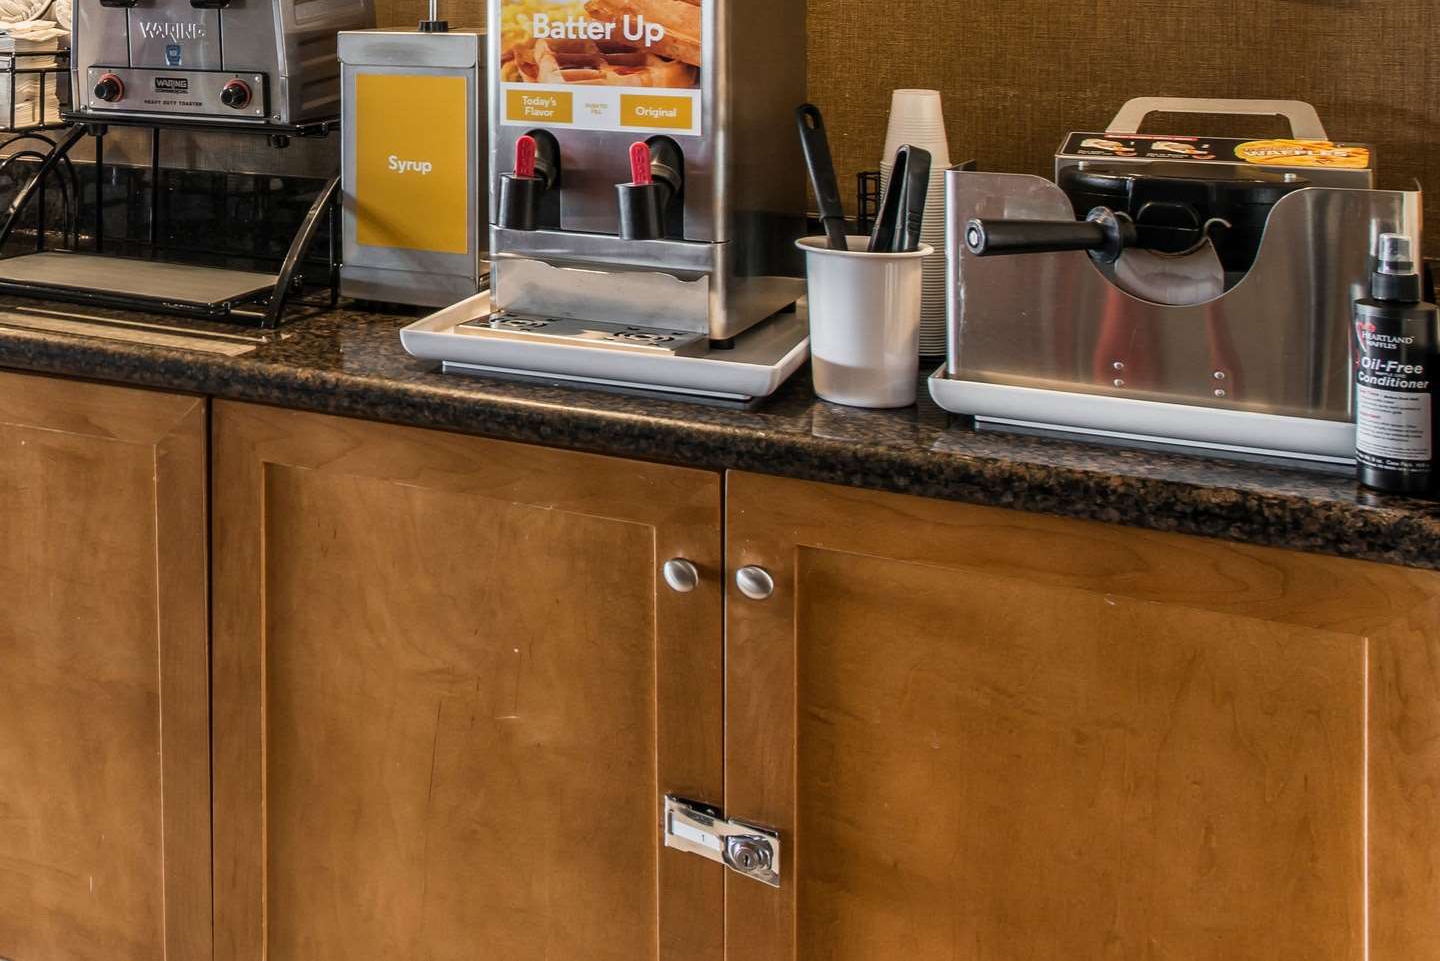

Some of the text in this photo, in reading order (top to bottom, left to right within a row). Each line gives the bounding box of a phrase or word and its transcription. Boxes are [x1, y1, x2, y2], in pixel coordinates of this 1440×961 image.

[140, 22, 206, 43] WARING
[532, 12, 665, 47] Batter Up
[156, 78, 187, 88] WARING
[522, 95, 557, 108] Today's
[524, 106, 555, 117] Flavor
[635, 106, 677, 119] Original
[388, 154, 433, 175] Syrup
[1361, 330, 1414, 344] HEARTLAND
[1361, 356, 1424, 375] Oil-Free
[1358, 371, 1430, 389] Conditioner
